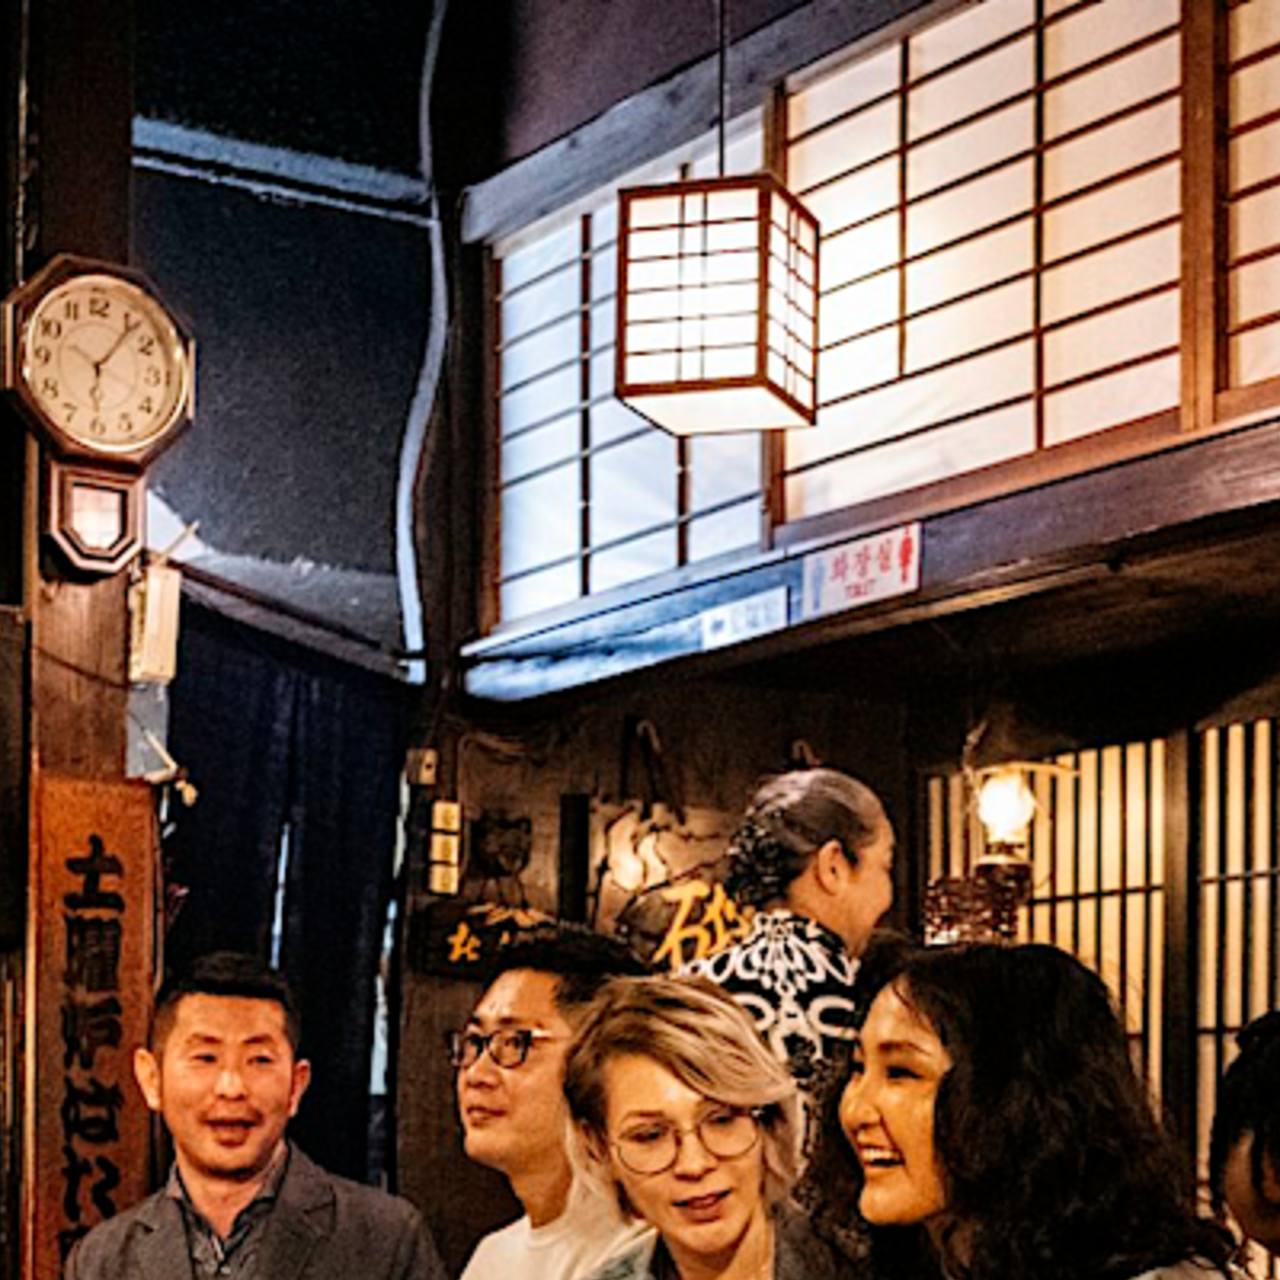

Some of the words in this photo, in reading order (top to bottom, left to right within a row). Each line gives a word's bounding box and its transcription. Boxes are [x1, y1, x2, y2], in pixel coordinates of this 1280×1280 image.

[66, 300, 79, 320] 11
[88, 296, 110, 318] 12
[39, 319, 62, 338] 10
[139, 336, 155, 356] 2
[36, 346, 51, 367] 9
[145, 366, 161, 385] 3
[42, 378, 59, 399] 8
[63, 405, 77, 423] 7
[139, 397, 153, 415] 4
[90, 418, 106, 436] 6
[118, 414, 133, 432] 5
